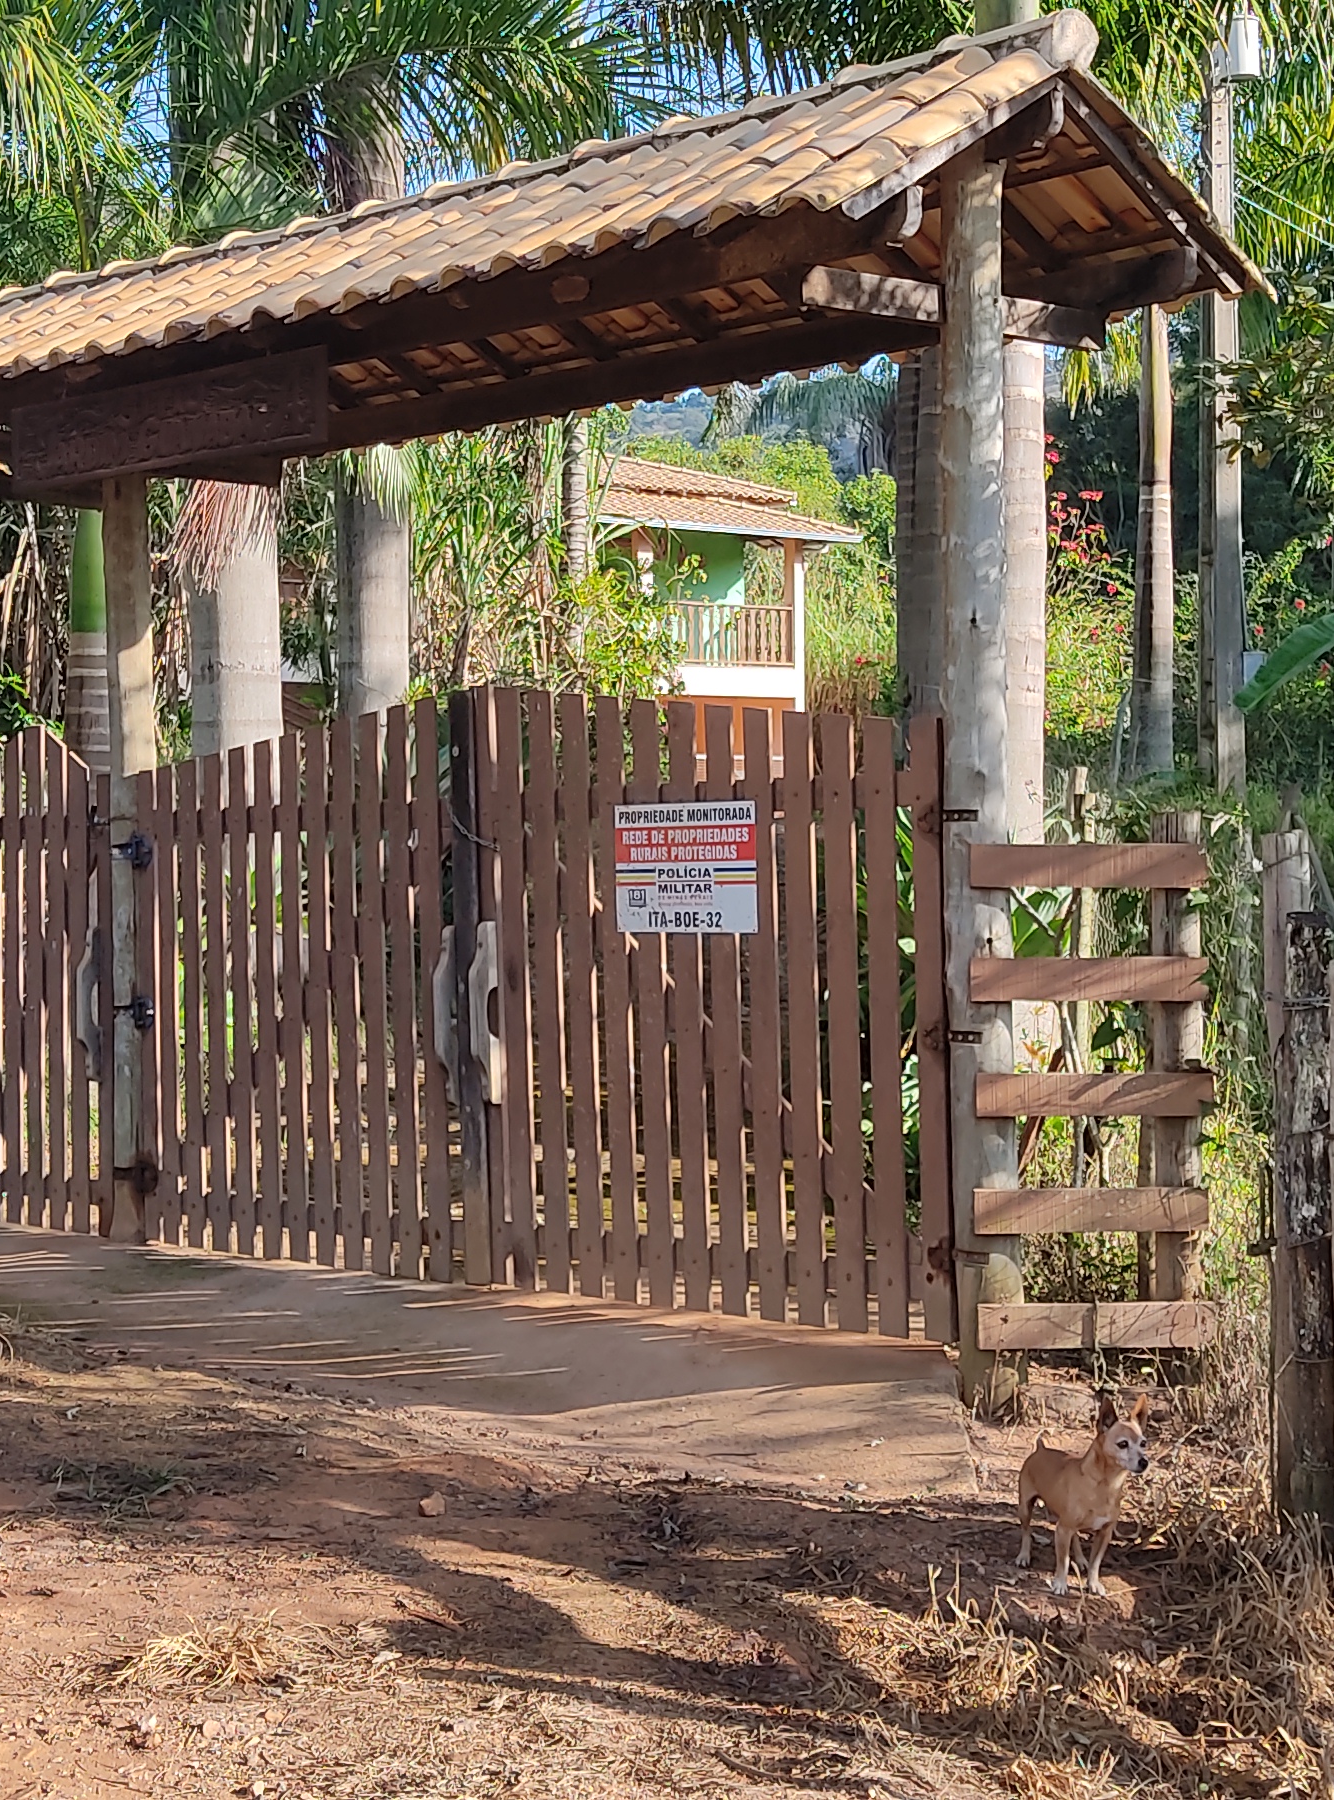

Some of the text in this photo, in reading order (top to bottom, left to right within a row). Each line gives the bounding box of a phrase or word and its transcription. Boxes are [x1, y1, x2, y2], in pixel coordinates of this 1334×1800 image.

[618, 806, 752, 825] PROPRIEDADE MONITORADA
[622, 827, 749, 845] REDE DE PROPRIEDADES
[630, 845, 738, 861] RURAIS PROTEGIDAS
[657, 865, 712, 879] POLÍCIA
[657, 883, 713, 894] MILITAR
[648, 911, 723, 929] ITA-BOE-32
